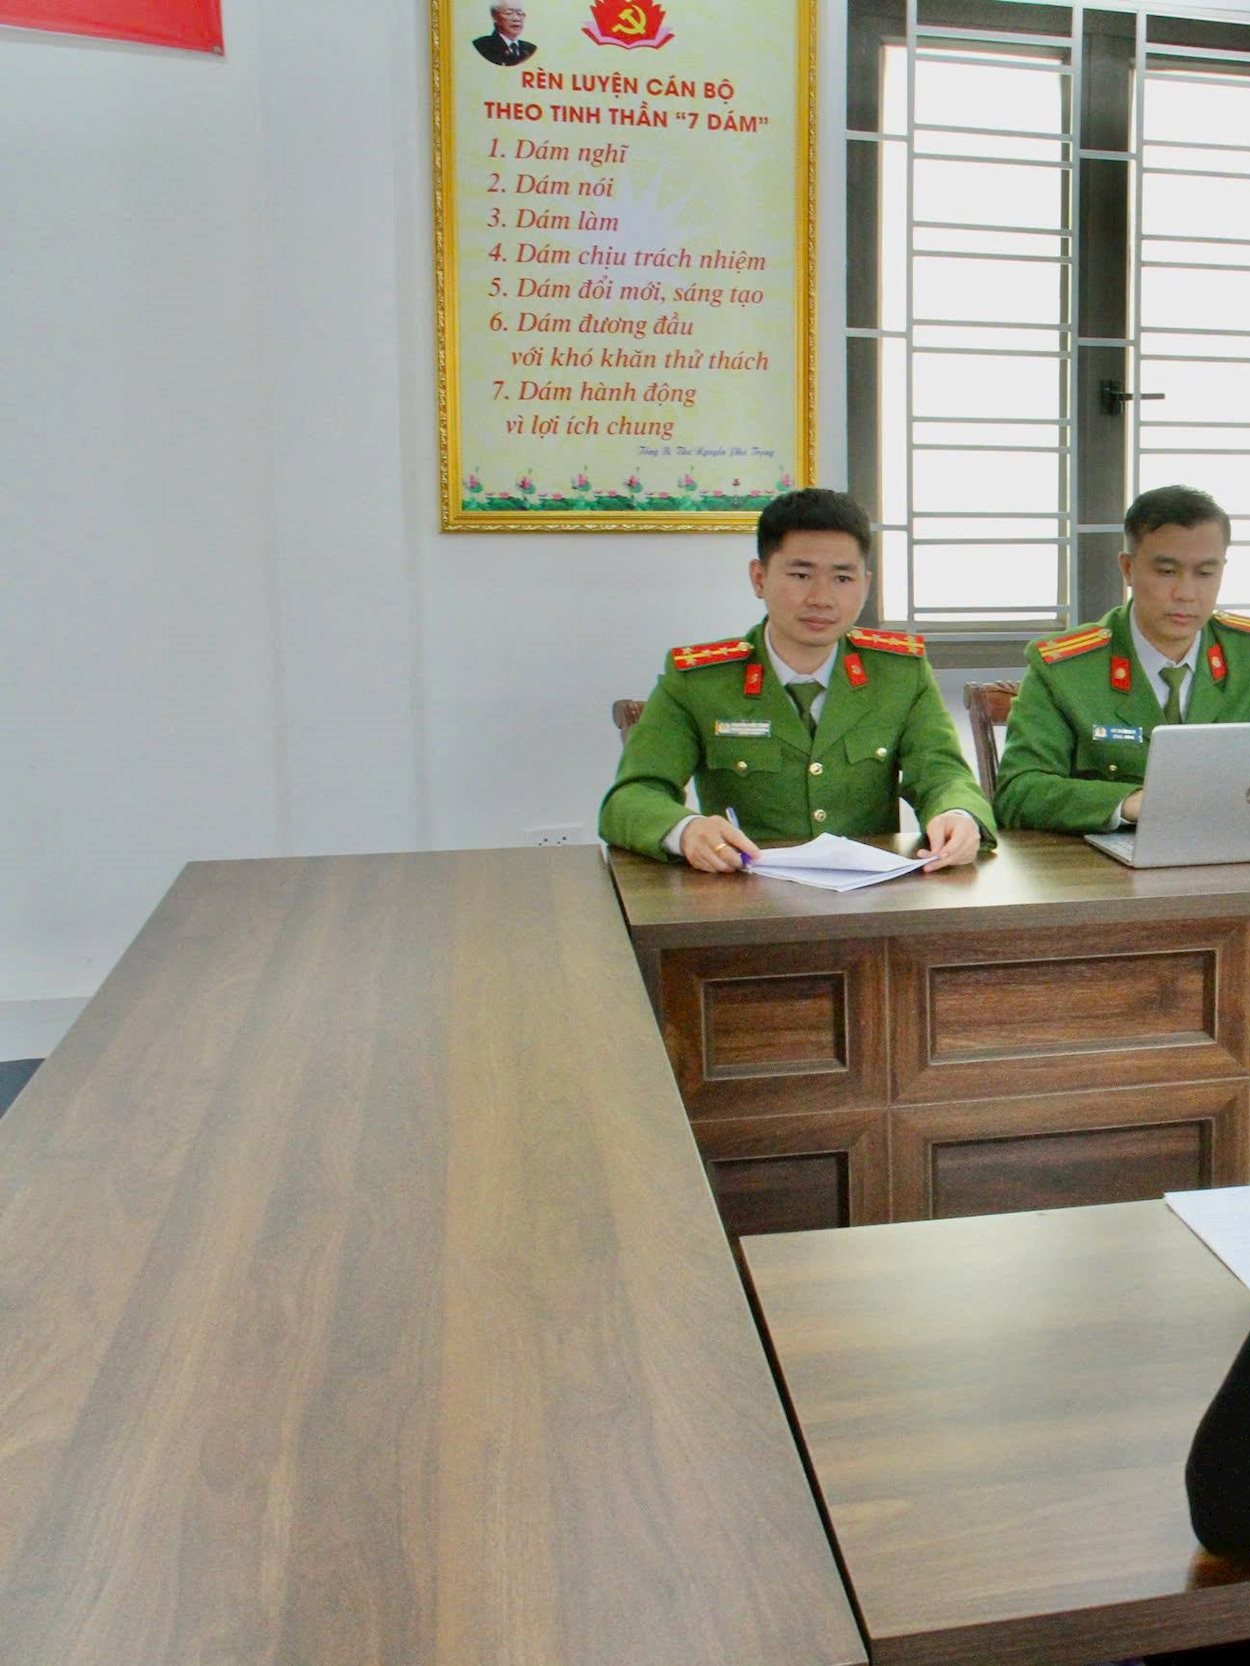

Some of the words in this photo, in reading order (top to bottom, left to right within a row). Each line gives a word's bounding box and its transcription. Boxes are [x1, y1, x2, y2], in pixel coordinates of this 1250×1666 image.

[522, 68, 563, 90] RÈN
[572, 72, 638, 98] LUYỆN
[647, 76, 695, 97] CÁN
[704, 79, 734, 104] BỘ
[484, 102, 542, 121] THEO
[551, 105, 600, 124] TINH
[609, 102, 667, 127] THẦN
[707, 109, 768, 133] DÁM”
[489, 138, 506, 158] 1.
[515, 139, 569, 161] Dám
[578, 143, 629, 167] nghĩ
[487, 173, 506, 193] 2.
[515, 174, 569, 196] Dám
[578, 177, 614, 198] nói
[487, 208, 506, 228] 3.
[516, 209, 569, 230] Dám
[578, 209, 618, 232] làm
[489, 243, 507, 262] 4.
[516, 244, 570, 265] Dám
[579, 245, 626, 271] chịu
[635, 247, 691, 267] trách
[700, 249, 766, 274] nhiệm
[489, 278, 507, 297] 5.
[516, 278, 570, 299] Dám
[578, 275, 613, 300] đổi
[620, 280, 665, 303] mới,
[674, 285, 722, 307] sáng
[730, 288, 763, 307] tạo
[490, 313, 508, 332] 6.
[517, 312, 571, 333] Dám
[578, 313, 648, 339] đương
[653, 311, 694, 336] đầu
[511, 346, 543, 367] với
[551, 347, 593, 368] khó
[601, 349, 657, 370] khăn
[665, 348, 703, 370] thử
[709, 351, 768, 372] thách
[493, 381, 509, 400] 7.
[519, 380, 571, 402] Dám
[580, 381, 636, 402] hành
[643, 383, 696, 407] động
[505, 417, 524, 435] vì
[532, 416, 558, 439] lợi
[566, 416, 599, 435] ích
[607, 417, 675, 440] chung
